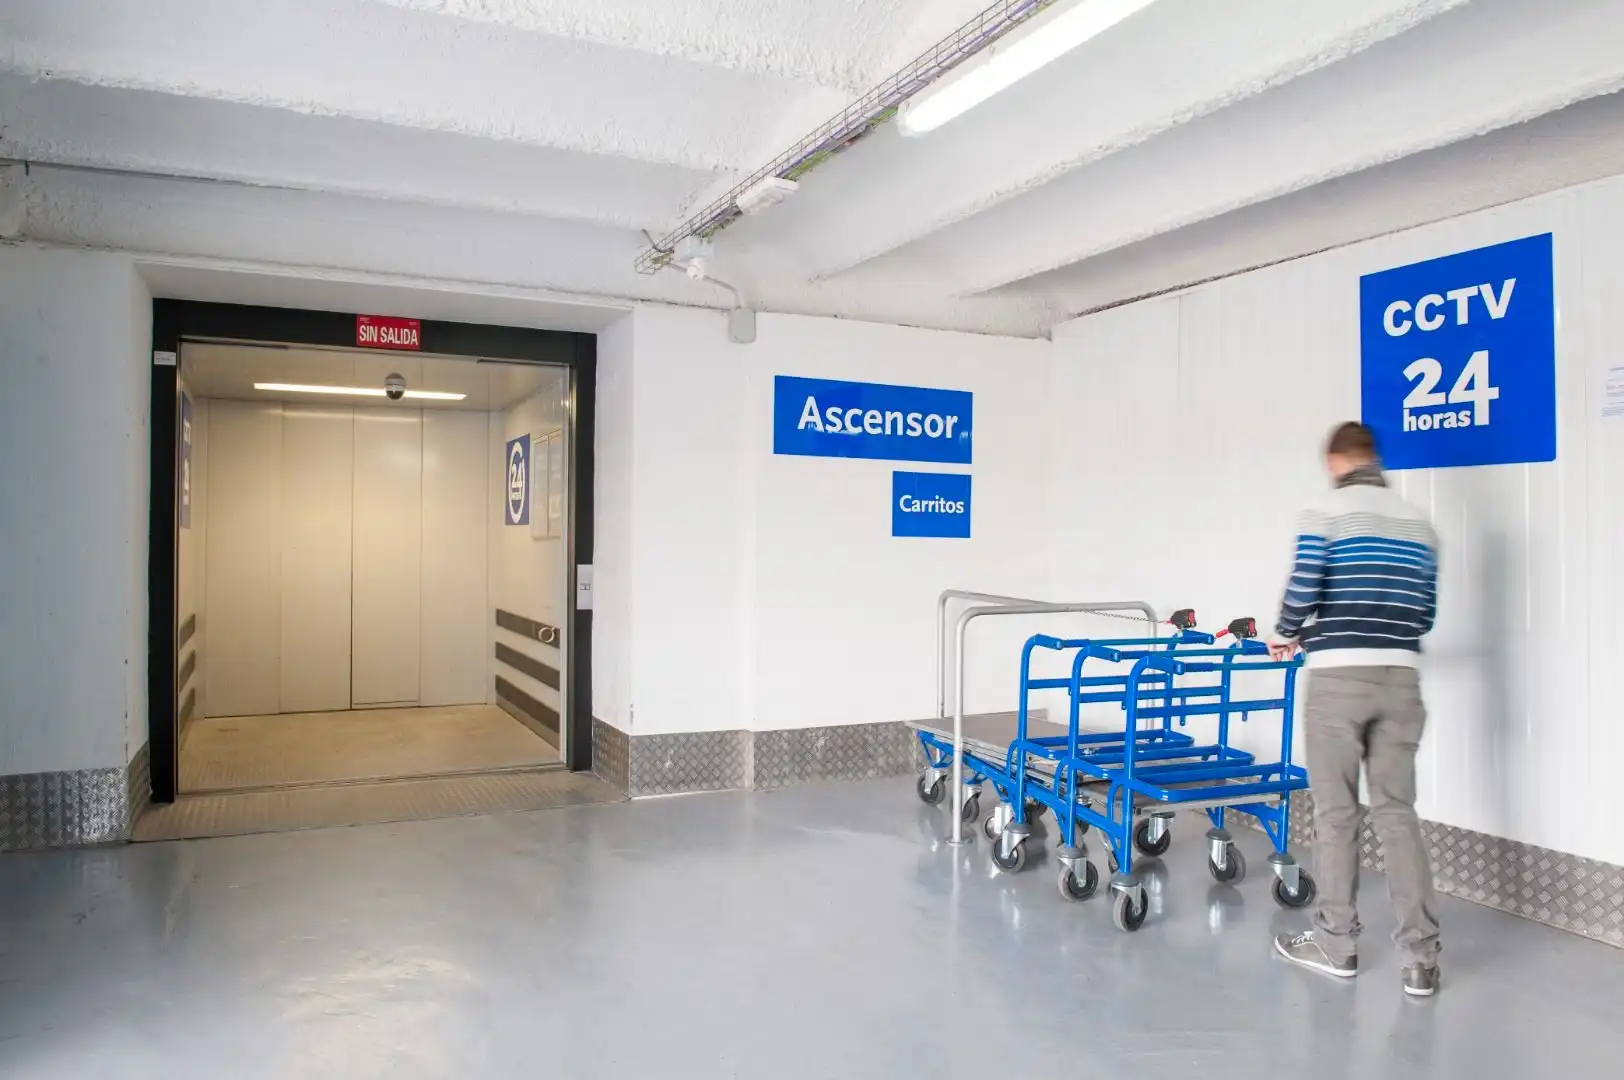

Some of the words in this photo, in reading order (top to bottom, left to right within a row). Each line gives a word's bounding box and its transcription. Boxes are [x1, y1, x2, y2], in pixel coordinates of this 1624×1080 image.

[1383, 278, 1516, 337] CCTV
[359, 325, 378, 343] SIN
[380, 326, 418, 345] SALIDA
[1403, 350, 1499, 425] 24
[797, 395, 959, 438] Ascensor
[1403, 408, 1471, 432] horas
[899, 495, 964, 514] Carritos
